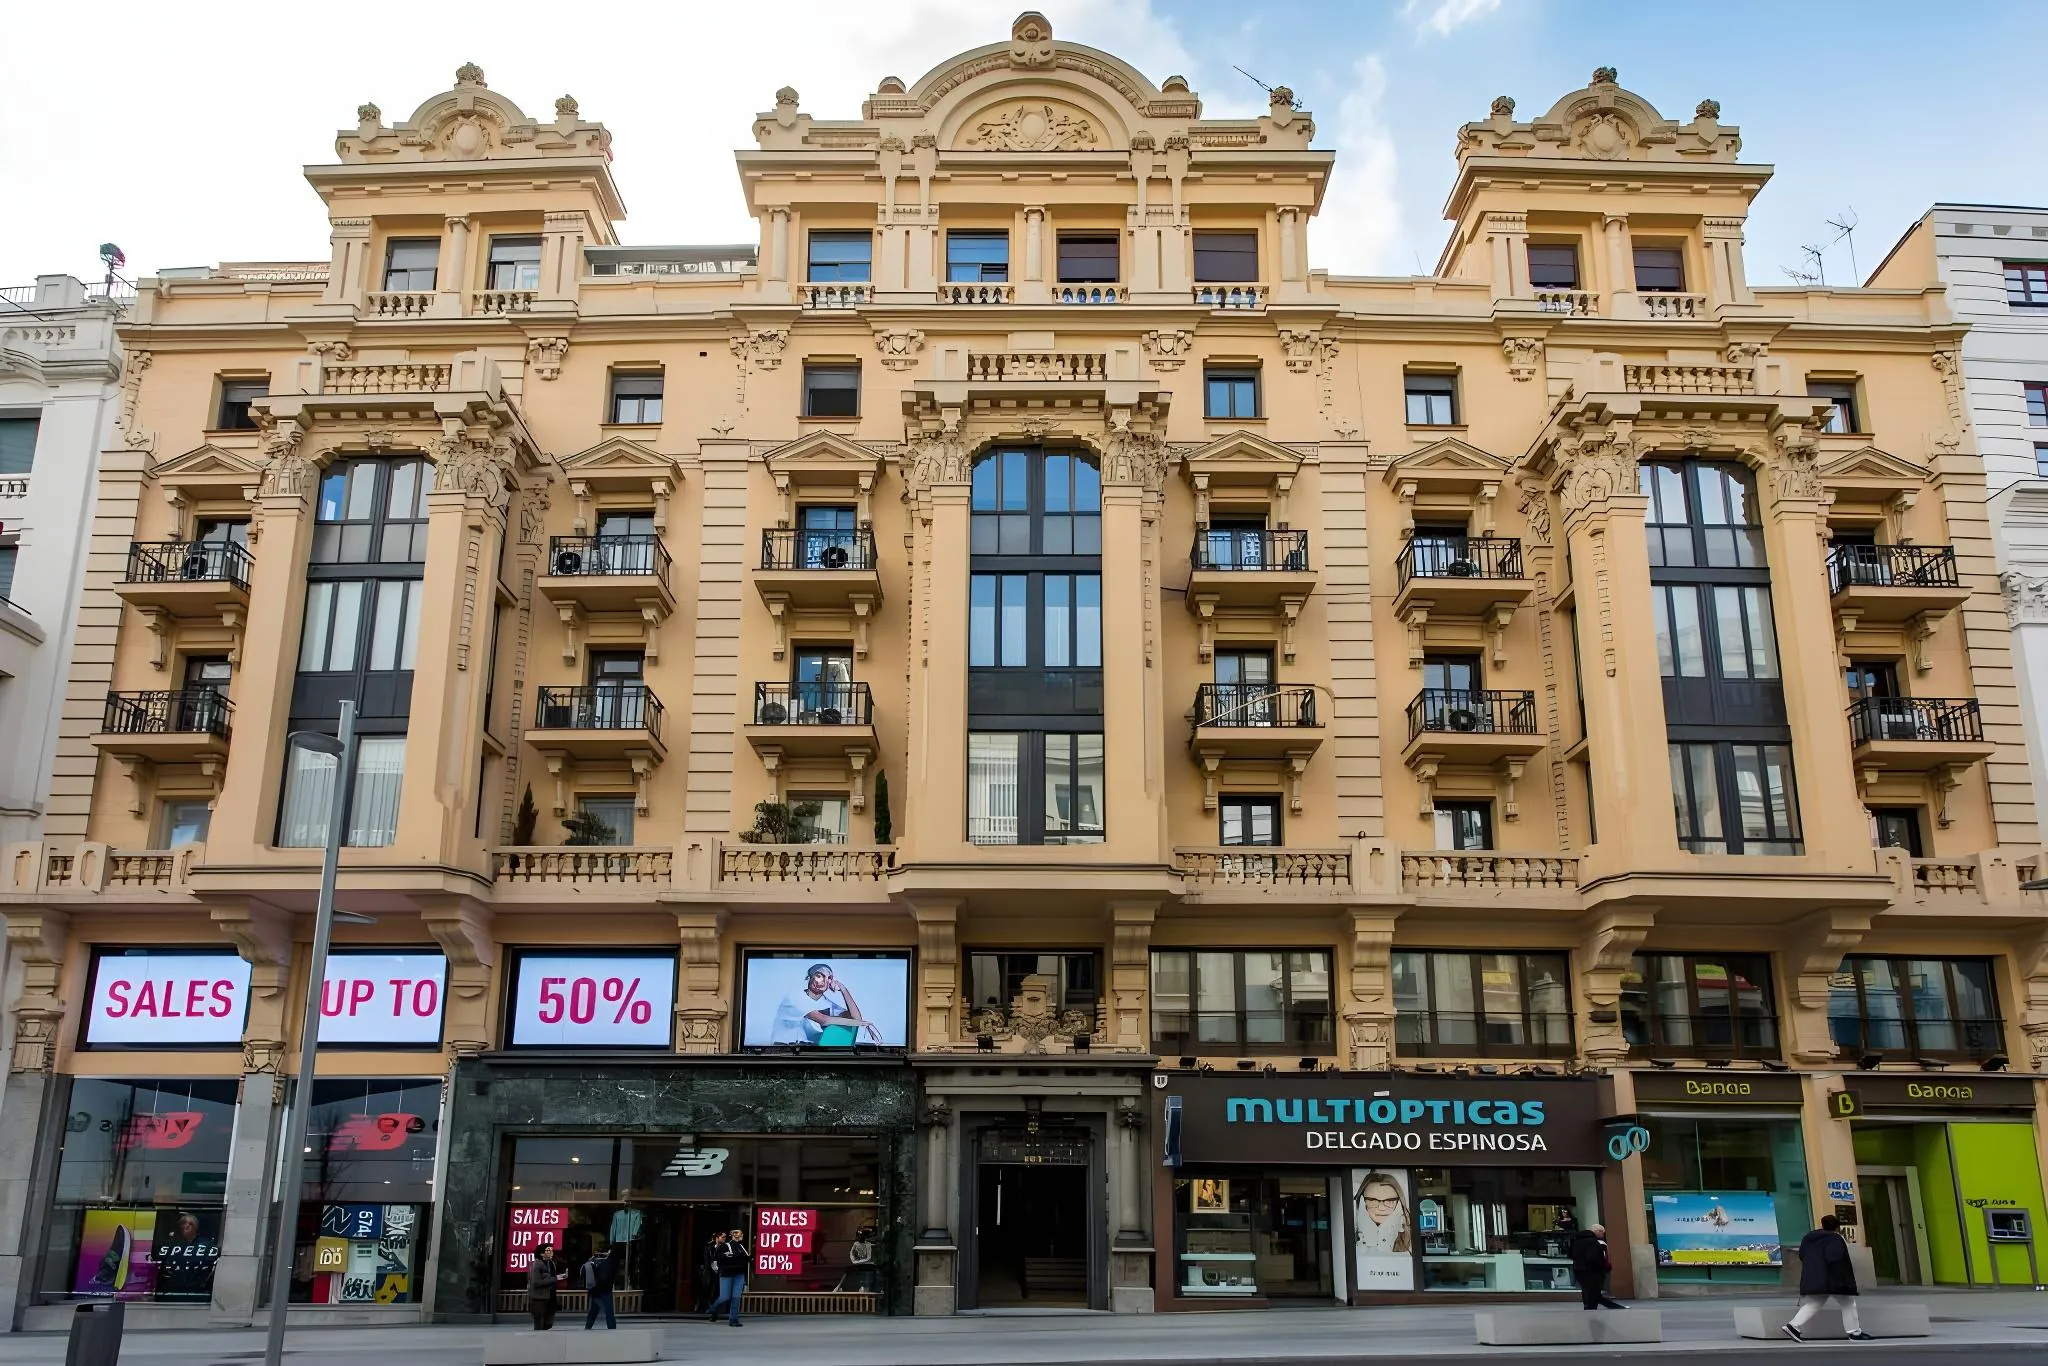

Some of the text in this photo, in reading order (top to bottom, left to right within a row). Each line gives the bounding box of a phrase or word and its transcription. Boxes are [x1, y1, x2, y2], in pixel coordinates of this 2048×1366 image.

[105, 979, 235, 1018] SALES
[321, 979, 438, 1017] UP TO
[538, 977, 652, 1025] 50%
[1306, 1131, 1548, 1151] DELGADO ESPINOSA
[513, 1208, 560, 1225] SALES
[761, 1211, 808, 1227] SALES
[512, 1231, 532, 1247] UP
[760, 1233, 803, 1248] UP TO
[158, 1244, 219, 1257] SPEED
